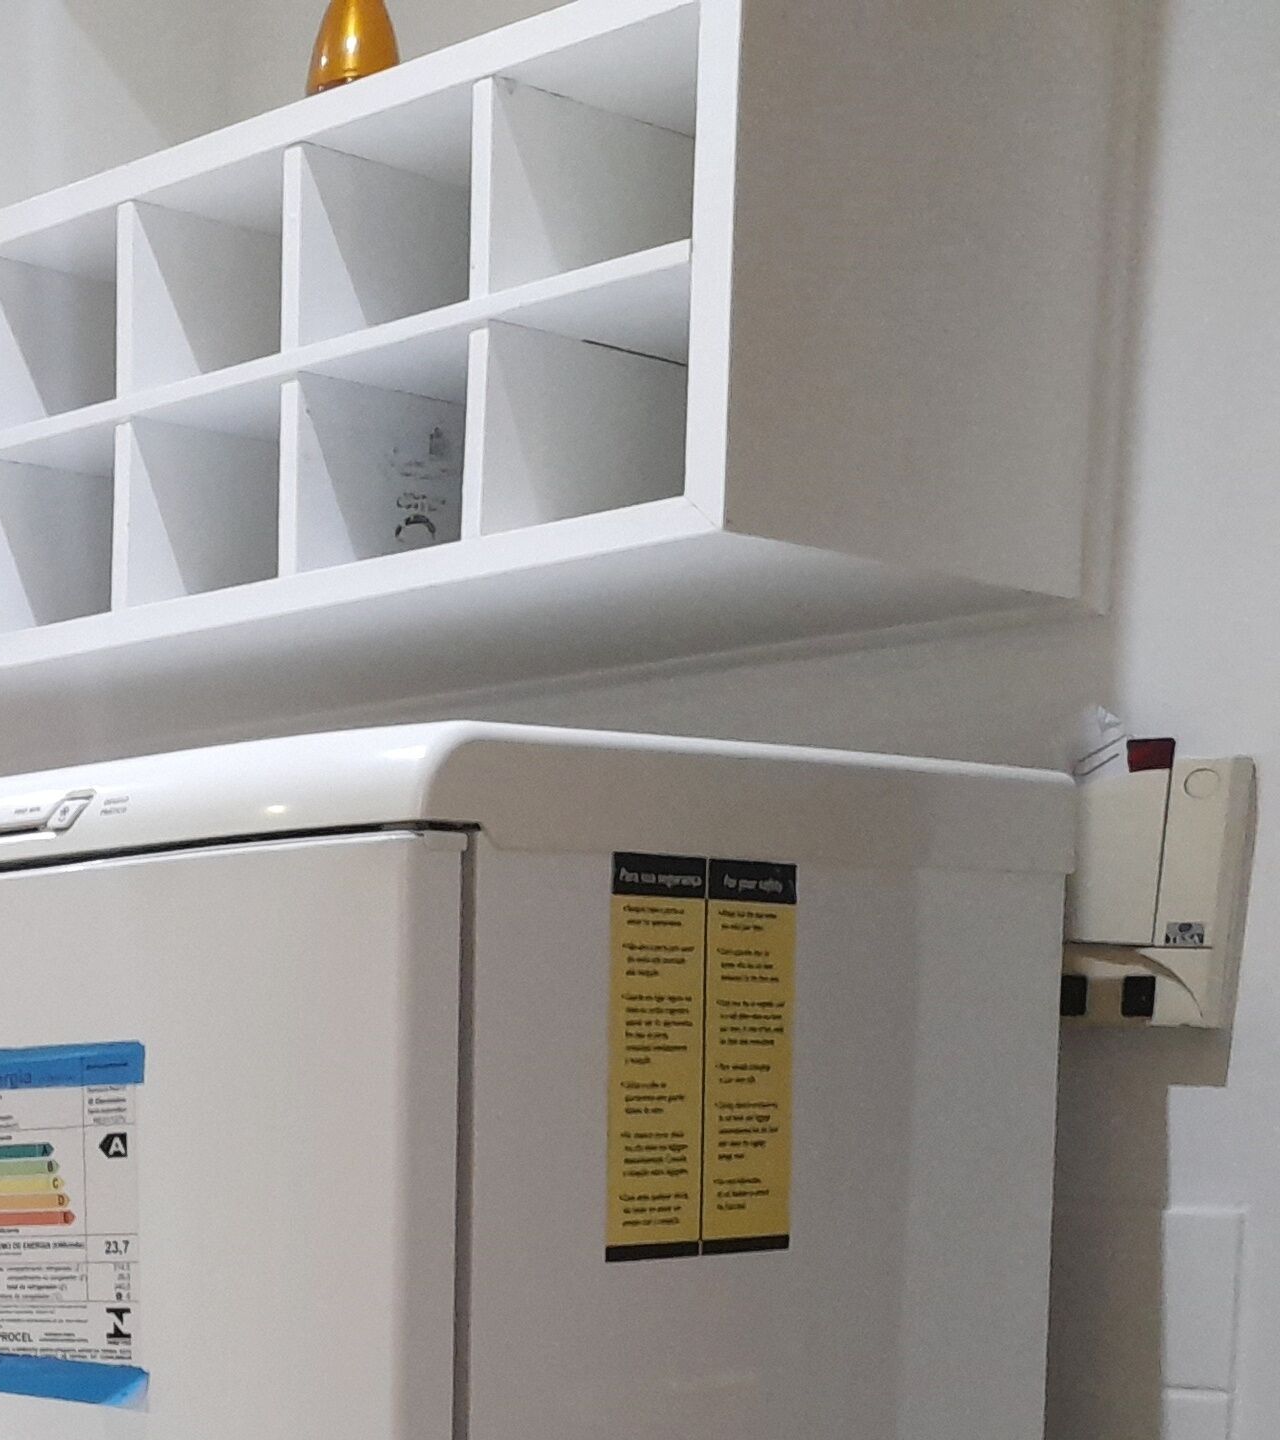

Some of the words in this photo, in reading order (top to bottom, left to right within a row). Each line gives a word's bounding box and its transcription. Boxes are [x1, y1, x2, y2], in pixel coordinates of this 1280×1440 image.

[108, 1136, 126, 1156] A
[47, 1160, 54, 1173] B
[52, 1177, 59, 1189] C
[58, 1195, 65, 1206] D
[104, 1240, 130, 1255] 23,7
